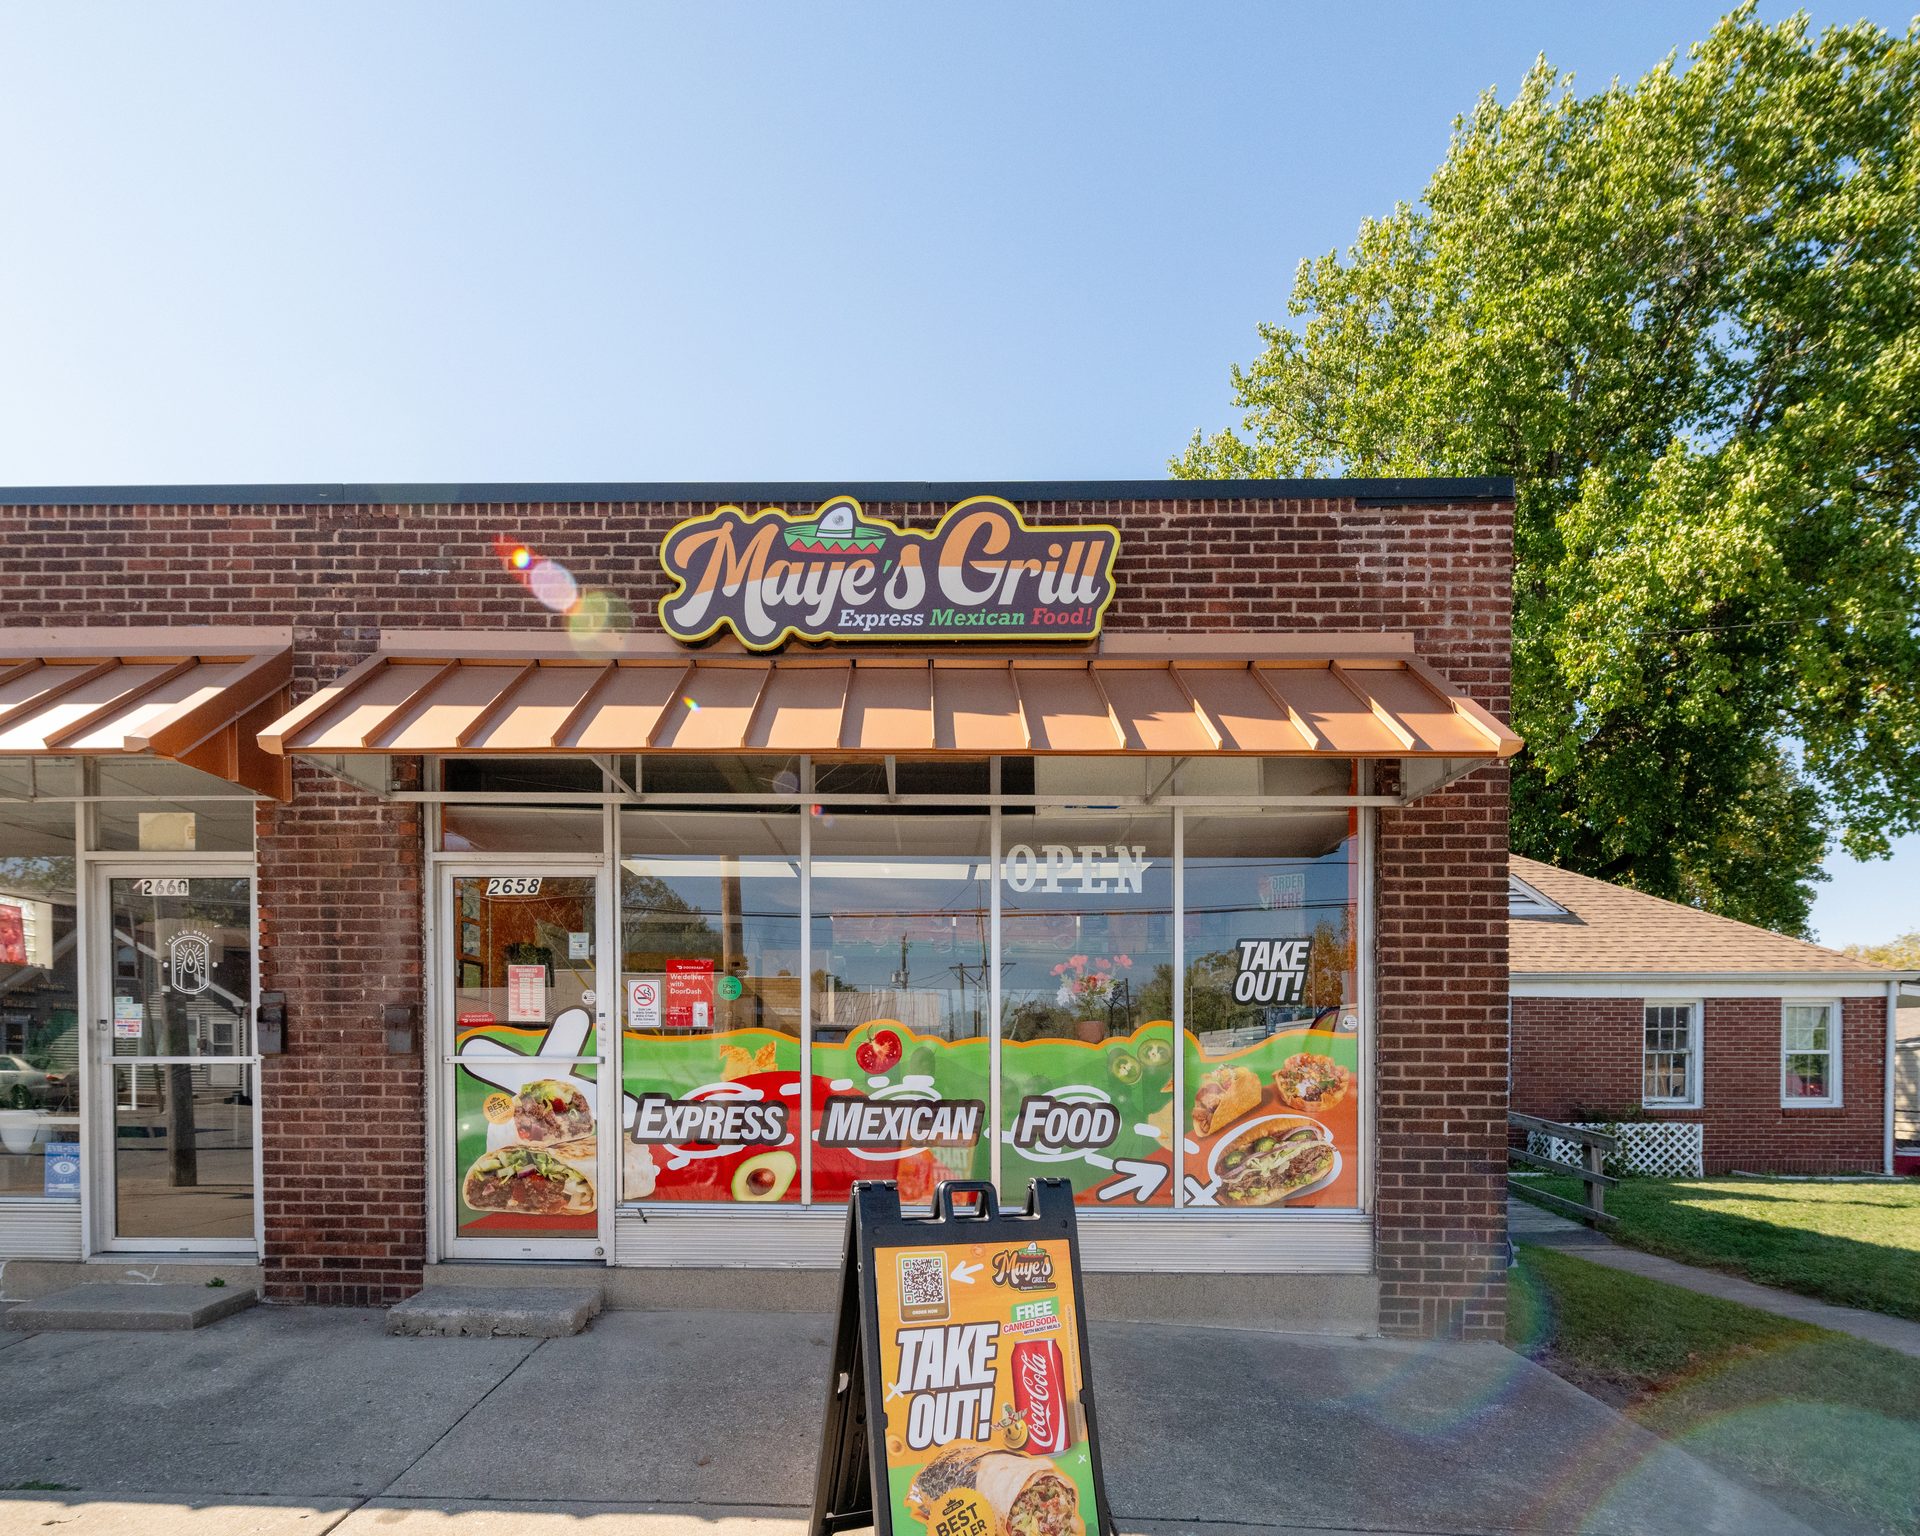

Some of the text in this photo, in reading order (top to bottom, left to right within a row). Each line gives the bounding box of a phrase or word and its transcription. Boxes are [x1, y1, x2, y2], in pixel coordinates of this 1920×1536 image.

[673, 511, 1106, 637] Maye's Grill
[838, 607, 1093, 631] Express Mexican Food!
[1005, 844, 1146, 894] OPEN
[1272, 875, 1303, 889] ORDER
[143, 880, 188, 895] 2660
[488, 879, 540, 895] 2658
[1239, 940, 1310, 971] TAKE
[1235, 971, 1305, 1001] OUT!
[487, 1098, 508, 1112] BEST
[637, 1098, 785, 1141] EXPRESS
[825, 1102, 978, 1140] MEXICAN
[1020, 1101, 1114, 1143] FOOD
[994, 1250, 1052, 1285] Maye's
[1003, 1315, 1057, 1333] CANNED SODA
[1016, 1300, 1053, 1320] FREE
[897, 1323, 999, 1392] TAKE
[908, 1387, 994, 1449] OUT!
[936, 1502, 977, 1536] BEST
